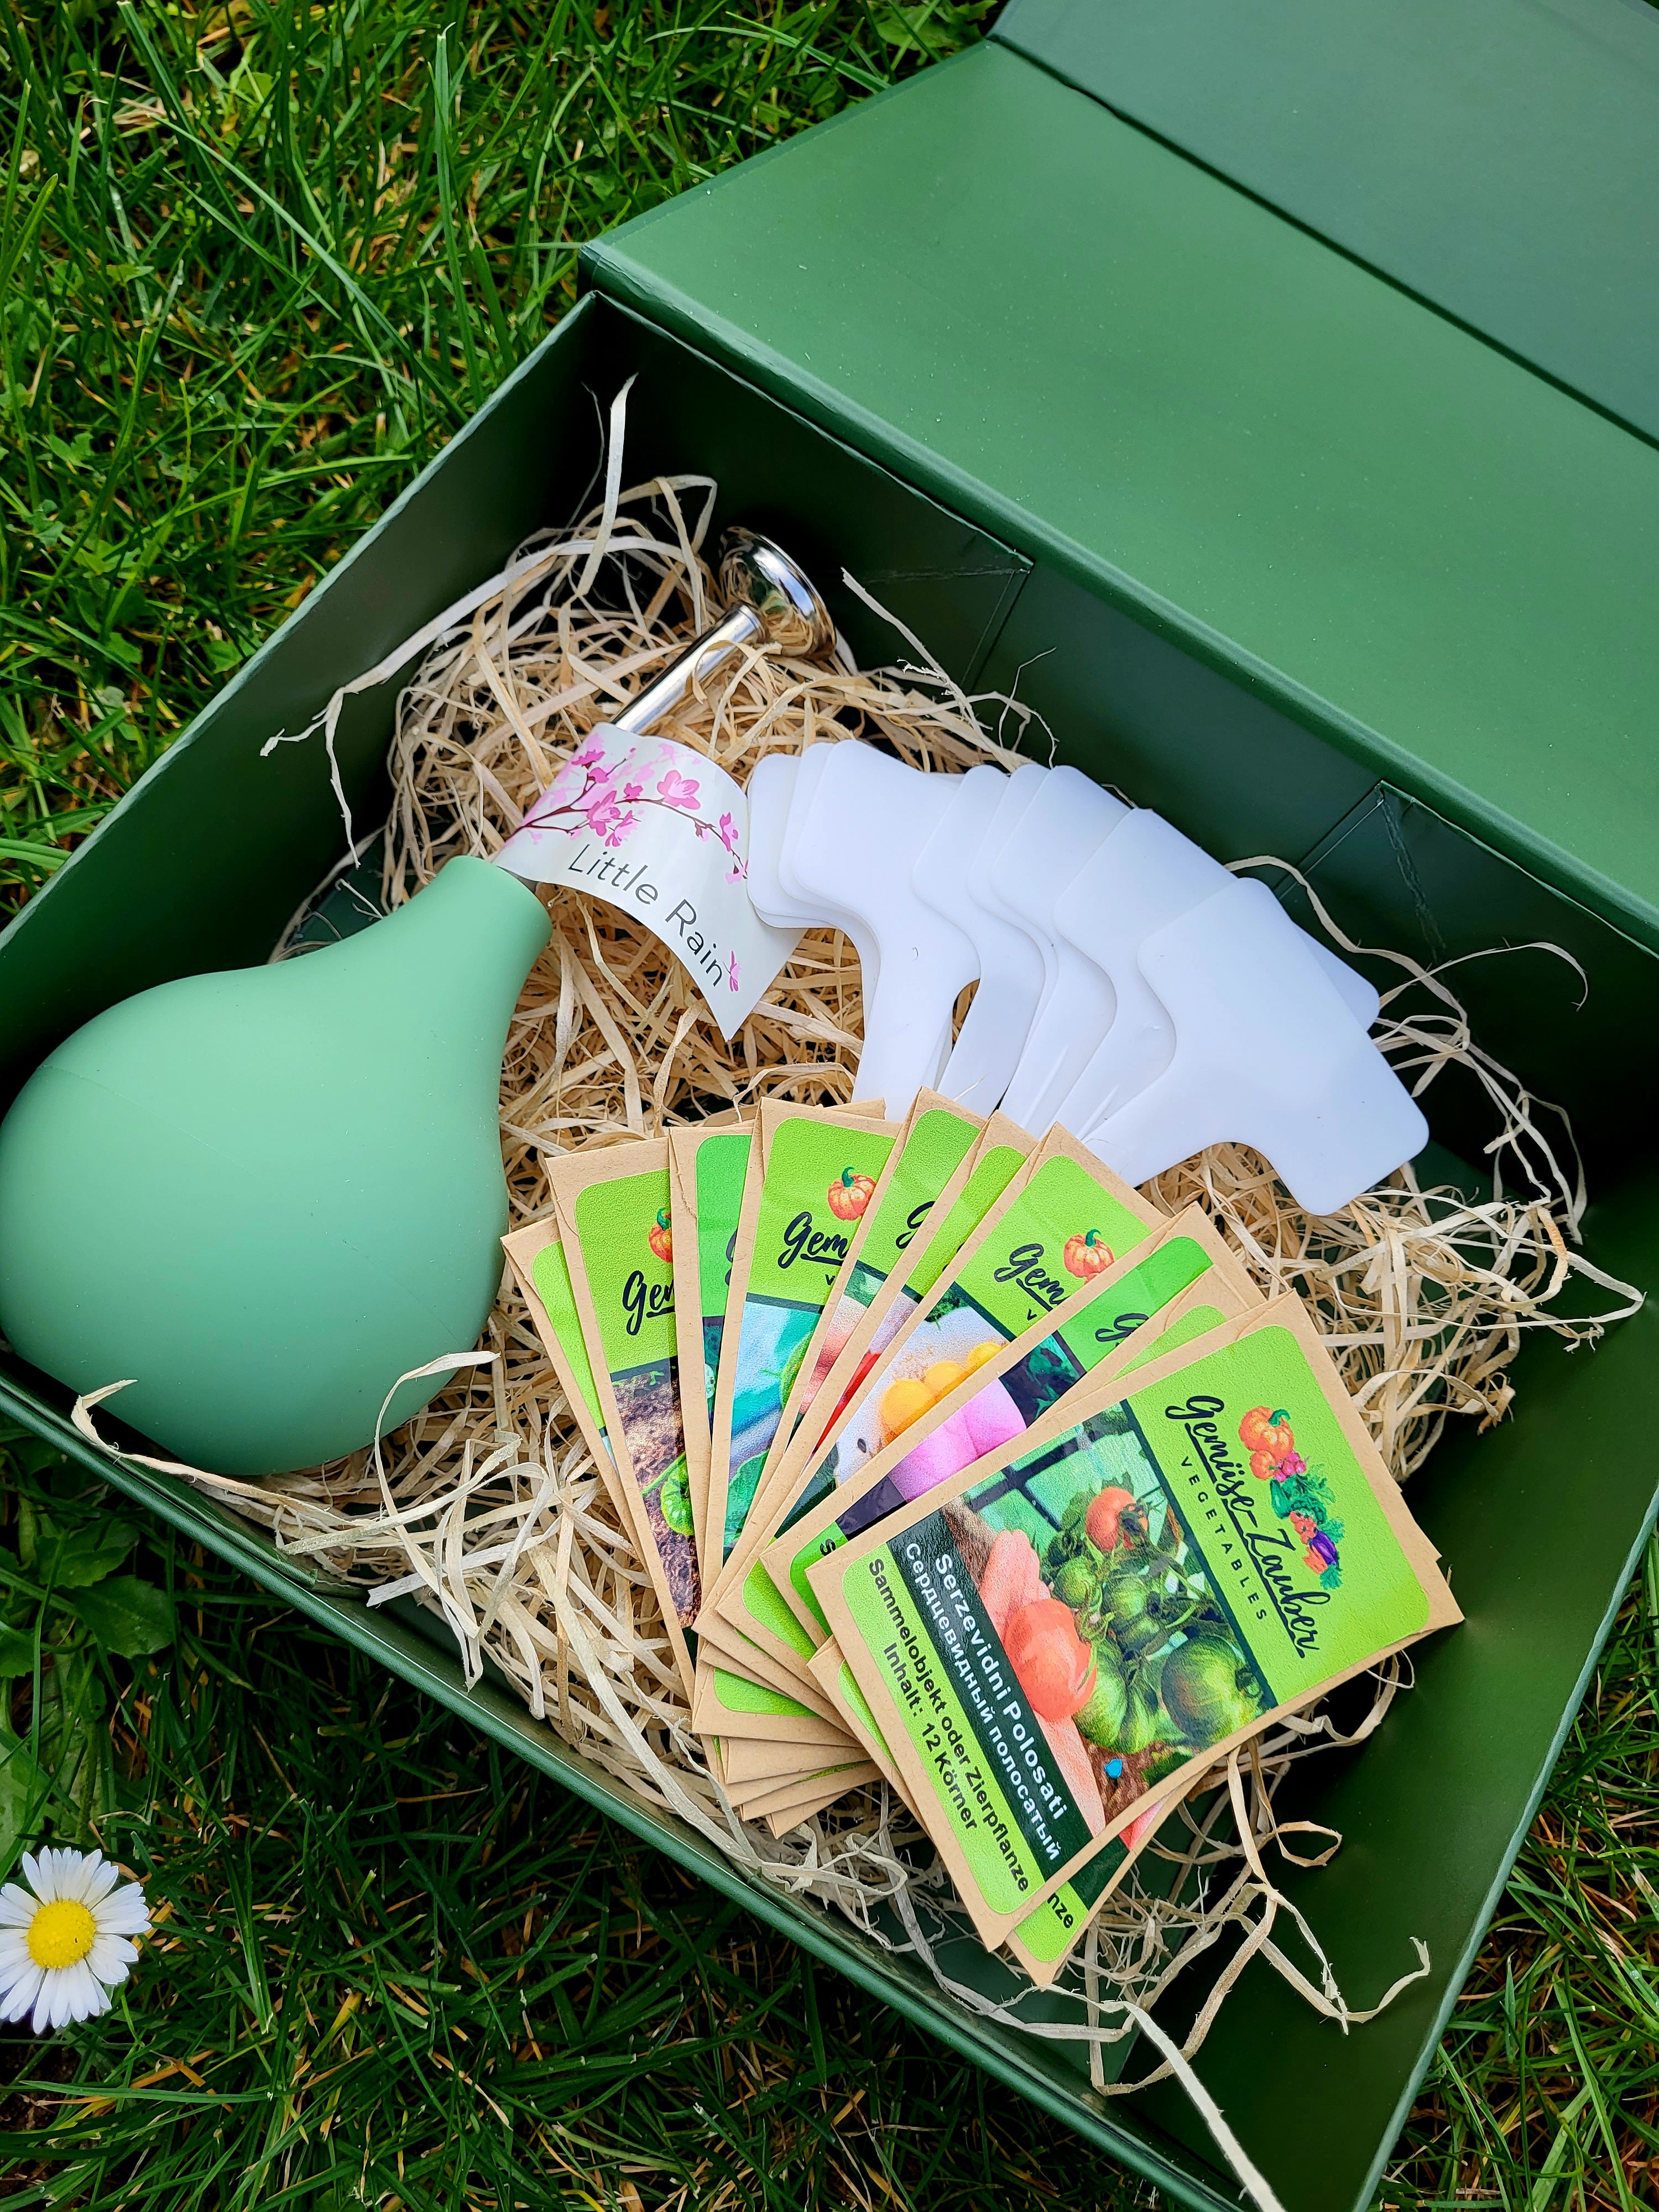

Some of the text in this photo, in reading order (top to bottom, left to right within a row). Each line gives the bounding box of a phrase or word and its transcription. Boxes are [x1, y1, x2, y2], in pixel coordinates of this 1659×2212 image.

[568, 844, 724, 987] Little Rain
[1165, 1395, 1331, 1651] Gemüse-Zauber
[1180, 1455, 1267, 1621] VEGETABLES
[869, 1558, 1029, 1892] Sammelobjekt oder Zierpflanze
[884, 1643, 977, 1832] Inhalt: 12 Körner
[906, 1542, 1061, 1861] Сердцевидный полосатый
[935, 1553, 1067, 1820] Serzevidni Polosati
